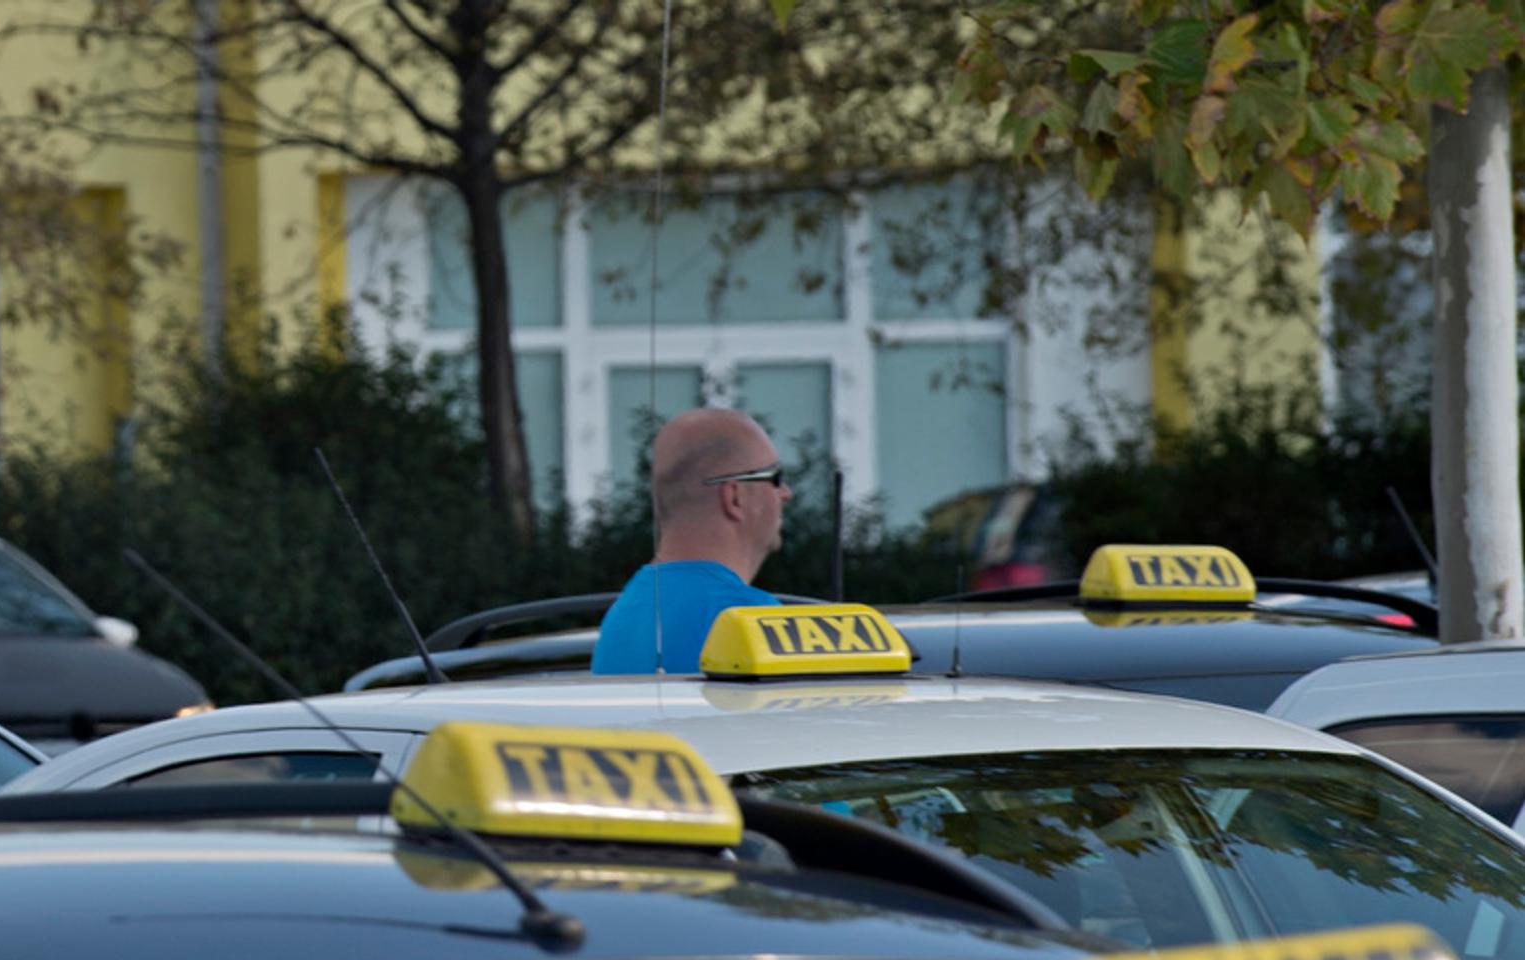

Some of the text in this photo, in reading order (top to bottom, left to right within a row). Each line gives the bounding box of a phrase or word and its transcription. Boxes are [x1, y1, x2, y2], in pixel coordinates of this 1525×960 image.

[1130, 556, 1239, 587] TAXI
[760, 616, 889, 653] TAXI
[503, 746, 713, 813] TAXI
